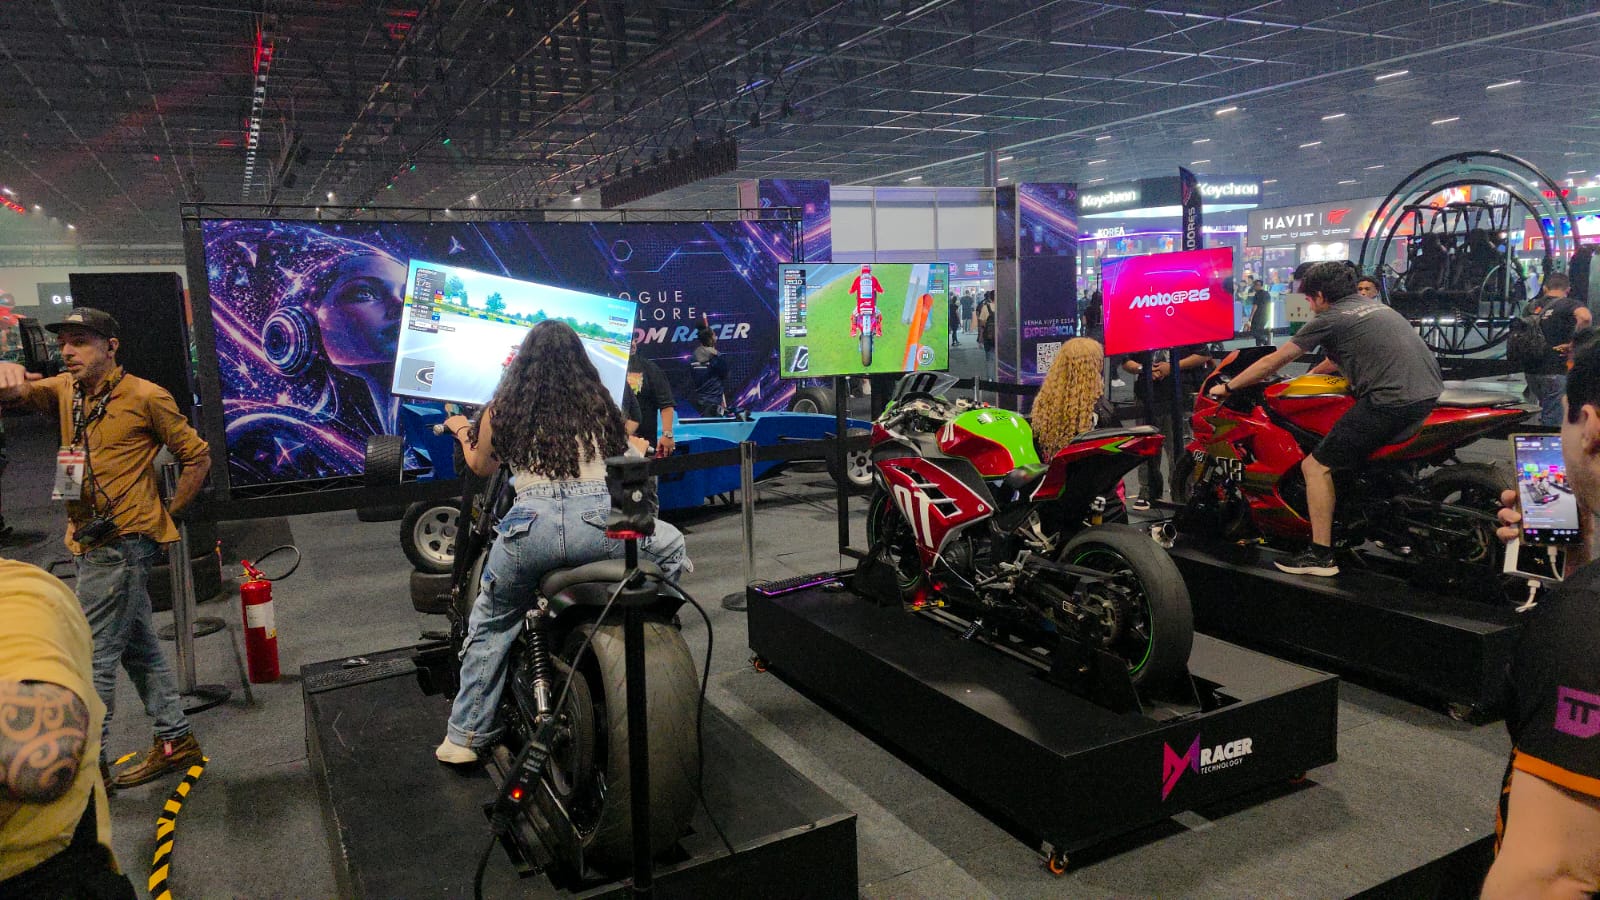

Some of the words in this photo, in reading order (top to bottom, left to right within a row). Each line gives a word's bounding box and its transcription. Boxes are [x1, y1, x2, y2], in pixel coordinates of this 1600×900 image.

[1197, 182, 1259, 199] Keychron
[1264, 213, 1314, 231] HAVIT
[1096, 226, 1125, 237] KOREA
[608, 291, 683, 304] OGUE
[639, 307, 697, 321] LORE
[1200, 737, 1253, 766] RACER
[1201, 759, 1243, 774] TECHNOLOGY
